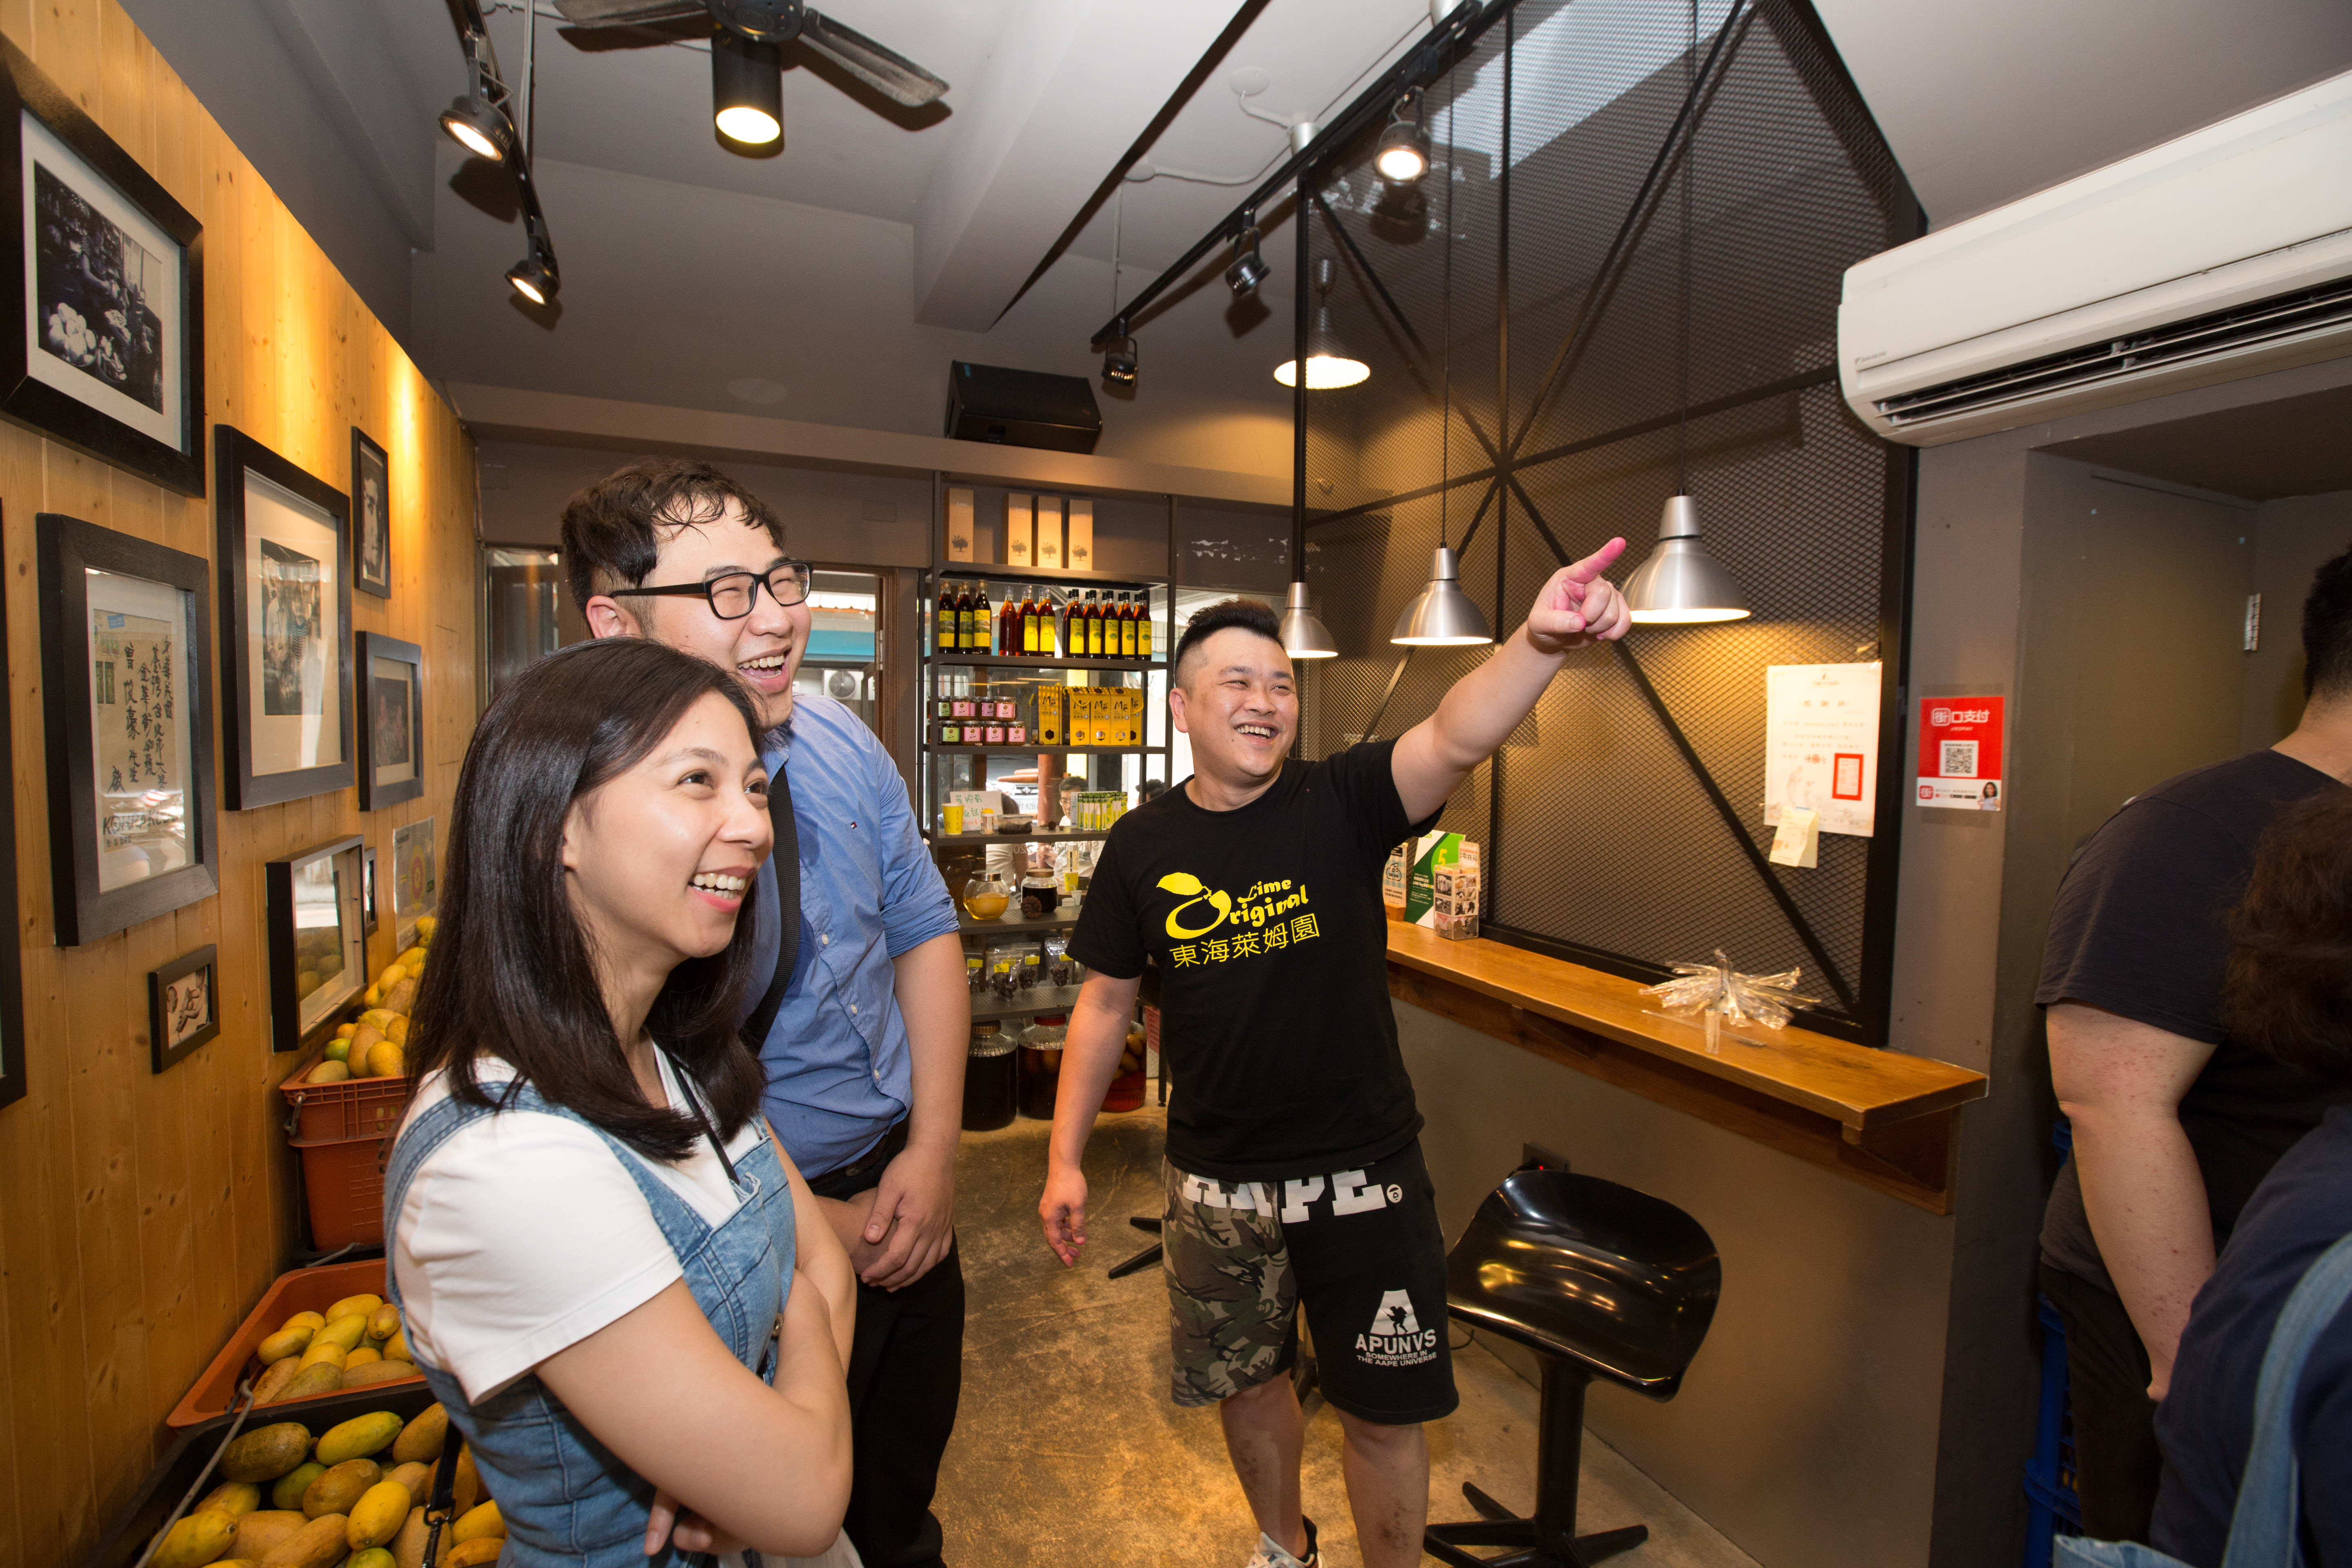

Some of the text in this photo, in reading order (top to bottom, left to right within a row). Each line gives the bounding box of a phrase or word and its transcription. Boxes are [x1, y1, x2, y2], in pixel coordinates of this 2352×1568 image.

[1932, 708, 1991, 726] 街口支付
[1237, 879, 1292, 902] Lime
[1169, 913, 1320, 969] 東海萊姆園
[1355, 1328, 1437, 1355] APUNVS
[1356, 1354, 1373, 1364] THE
[1400, 1352, 1437, 1366] UNIVERSE
[1365, 1349, 1428, 1361] SOMEWHERE IN
